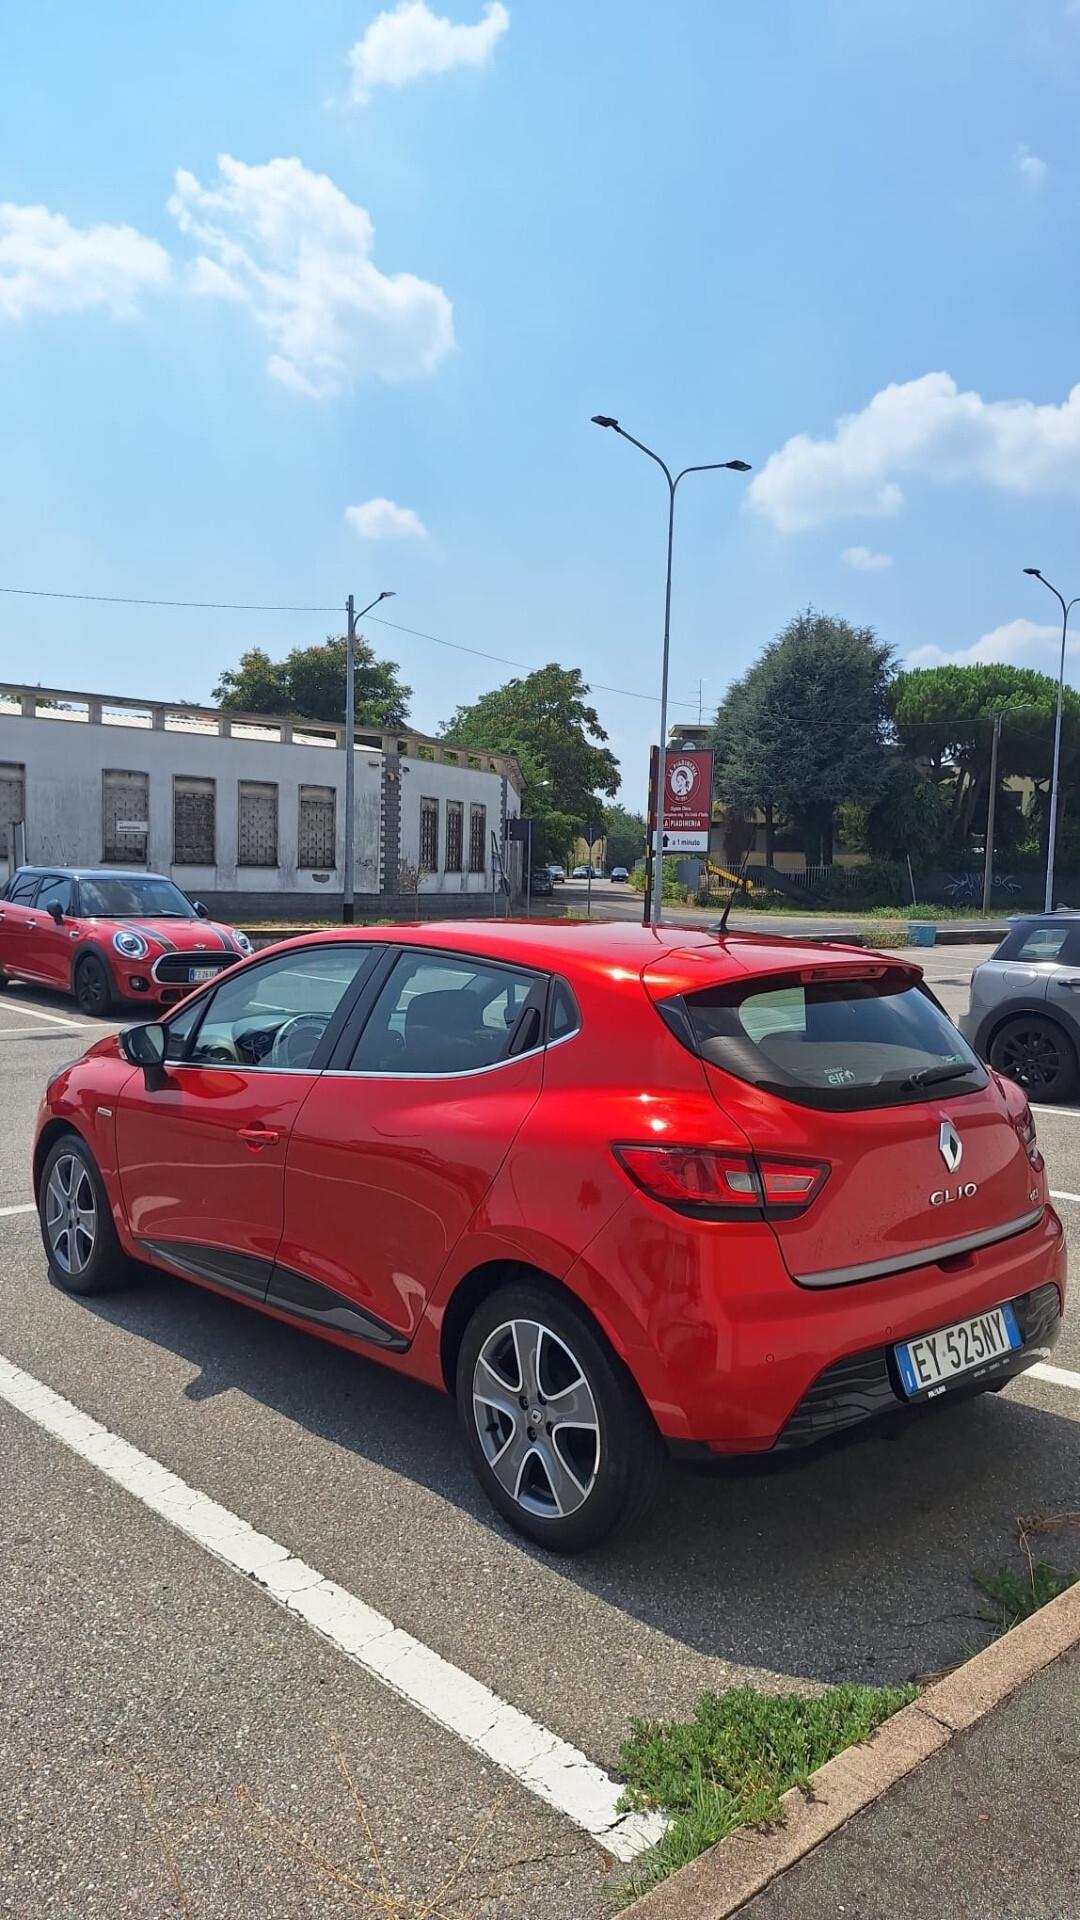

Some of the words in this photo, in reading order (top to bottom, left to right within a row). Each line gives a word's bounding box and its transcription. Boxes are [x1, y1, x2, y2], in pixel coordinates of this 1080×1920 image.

[670, 819, 701, 827] PIADINERIA
[930, 1183, 977, 1205] CLIO
[911, 1337, 942, 1383] EY
[945, 1311, 1006, 1370] 525NY
